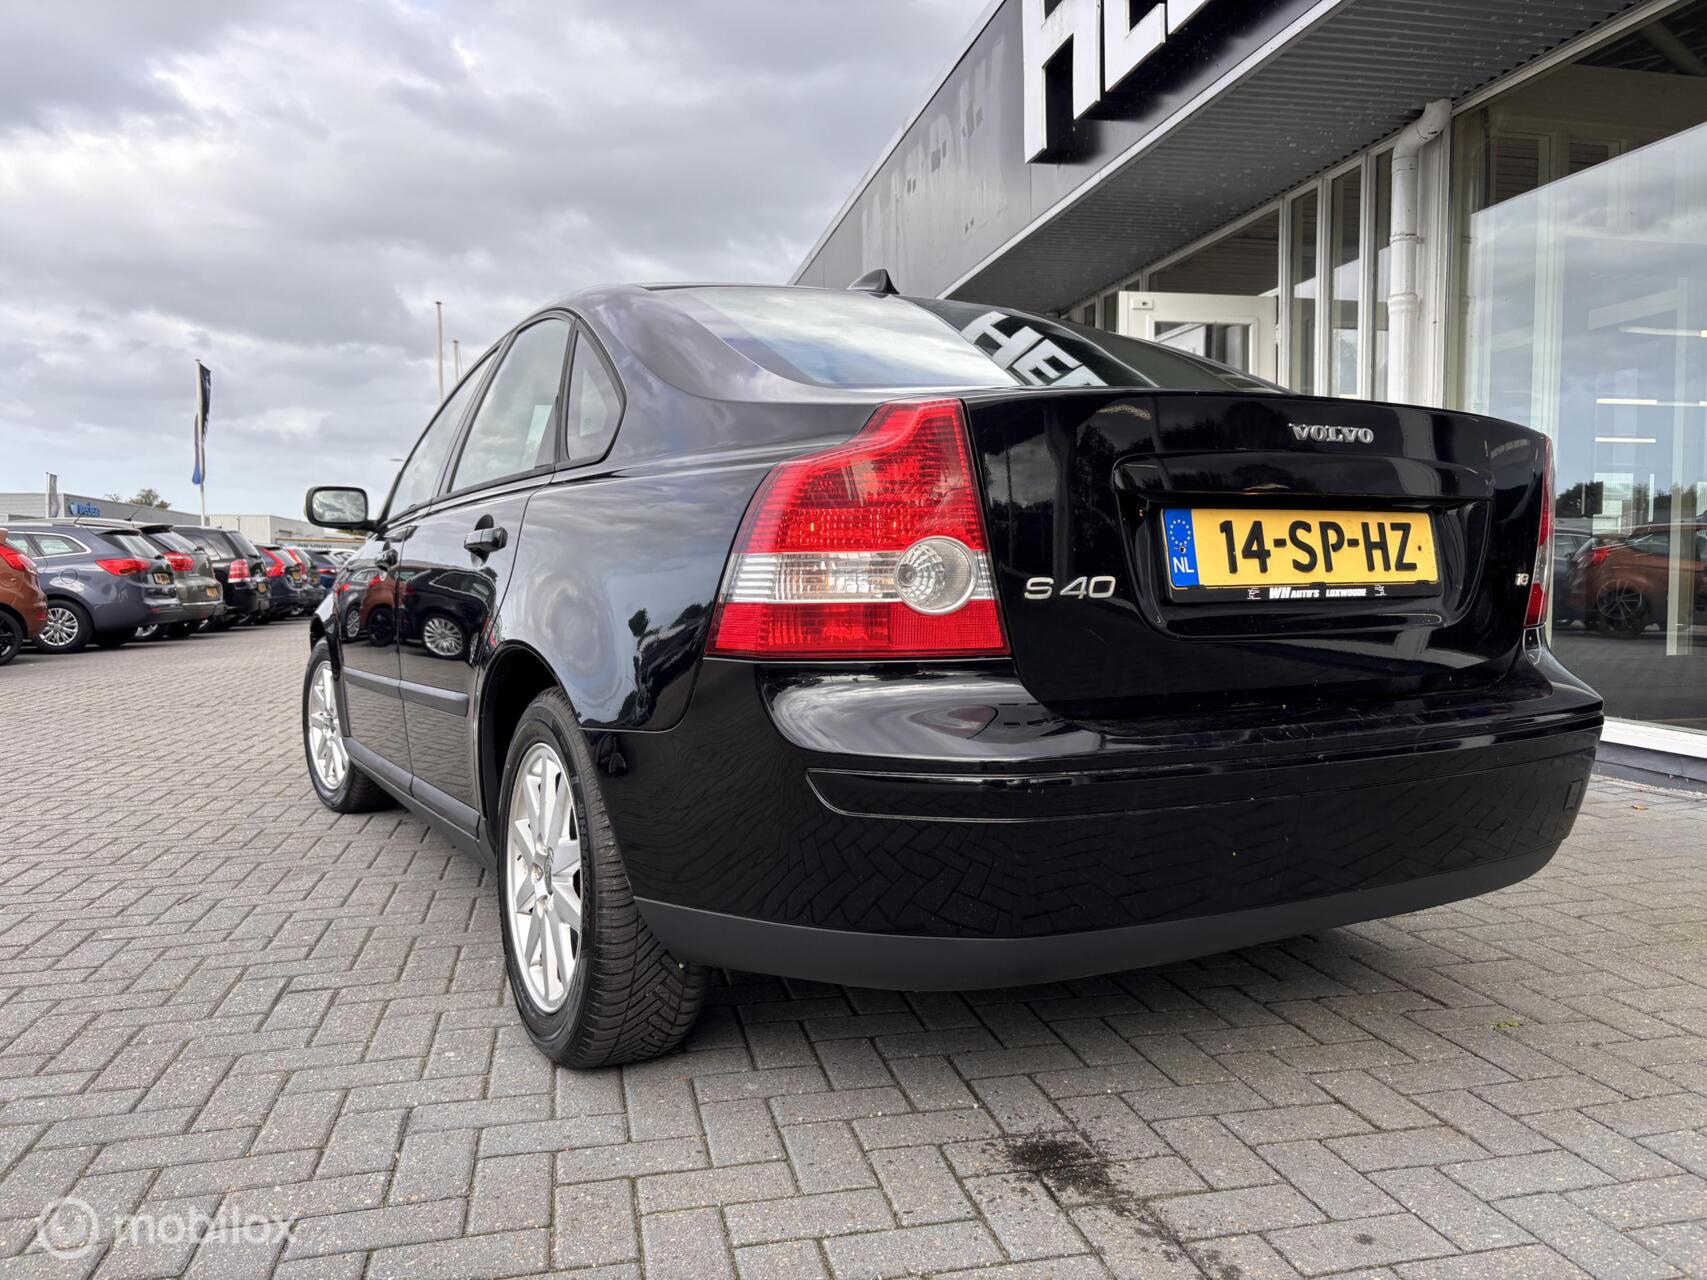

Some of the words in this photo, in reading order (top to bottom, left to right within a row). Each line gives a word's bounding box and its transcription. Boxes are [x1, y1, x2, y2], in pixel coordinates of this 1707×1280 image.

[1289, 423, 1374, 443] VOLVO
[1219, 520, 1418, 574] 14-SP-HZ
[1173, 556, 1195, 574] NL
